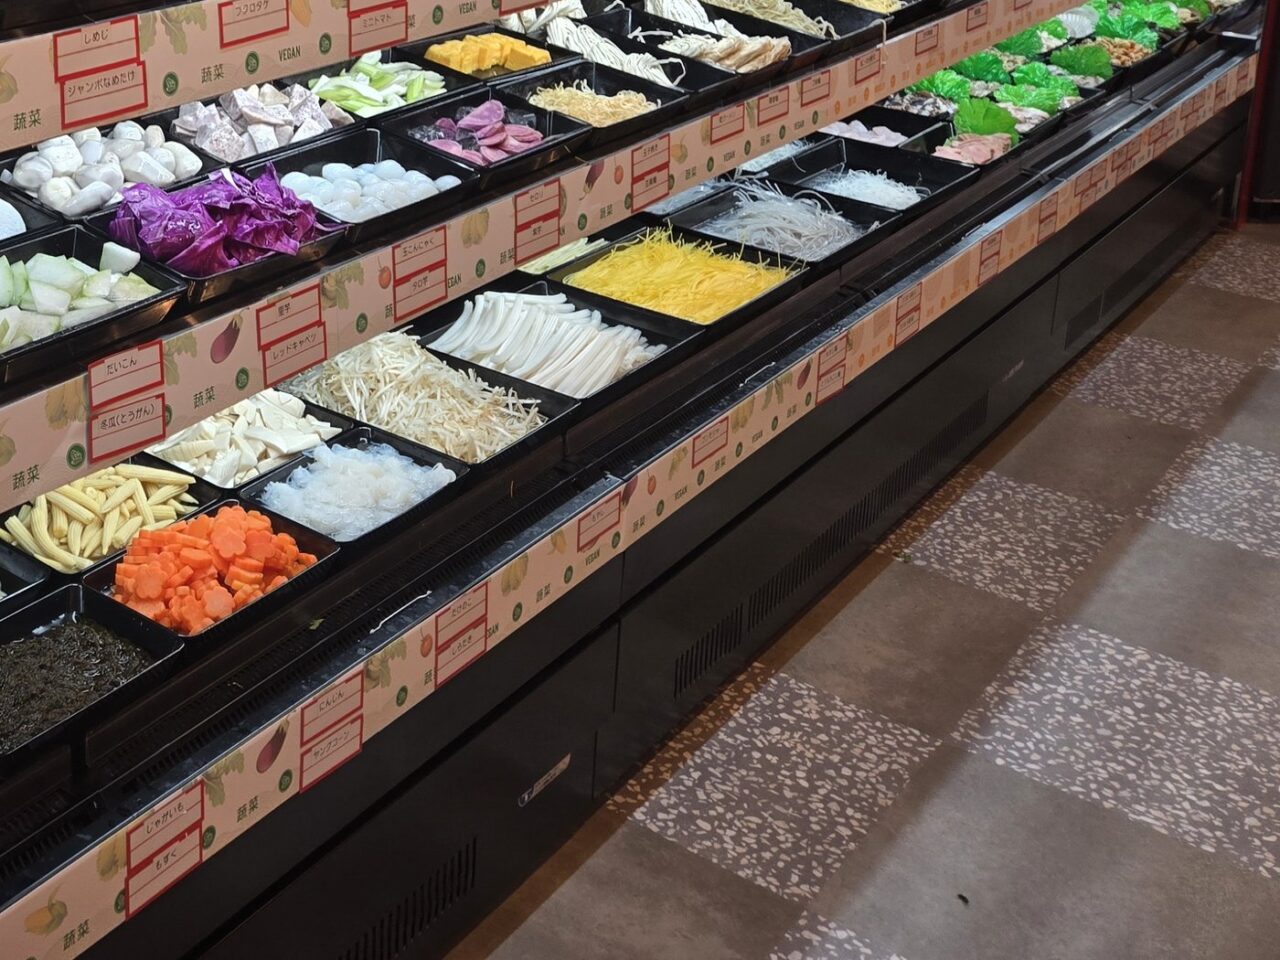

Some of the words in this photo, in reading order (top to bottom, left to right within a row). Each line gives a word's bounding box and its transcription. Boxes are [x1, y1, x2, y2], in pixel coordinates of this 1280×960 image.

[459, 1, 476, 15] VEGAN
[83, 29, 110, 44] しめじ
[278, 45, 301, 62] VEGAN
[201, 64, 224, 82] 蔬菜
[13, 109, 41, 131] 蔬菜
[107, 357, 137, 375] だいこん
[193, 387, 215, 409] 蔬菜
[100, 403, 155, 430] 冬瓜(とうがん)
[12, 464, 40, 491] 蔬菜
[146, 802, 185, 834] じゃがいも
